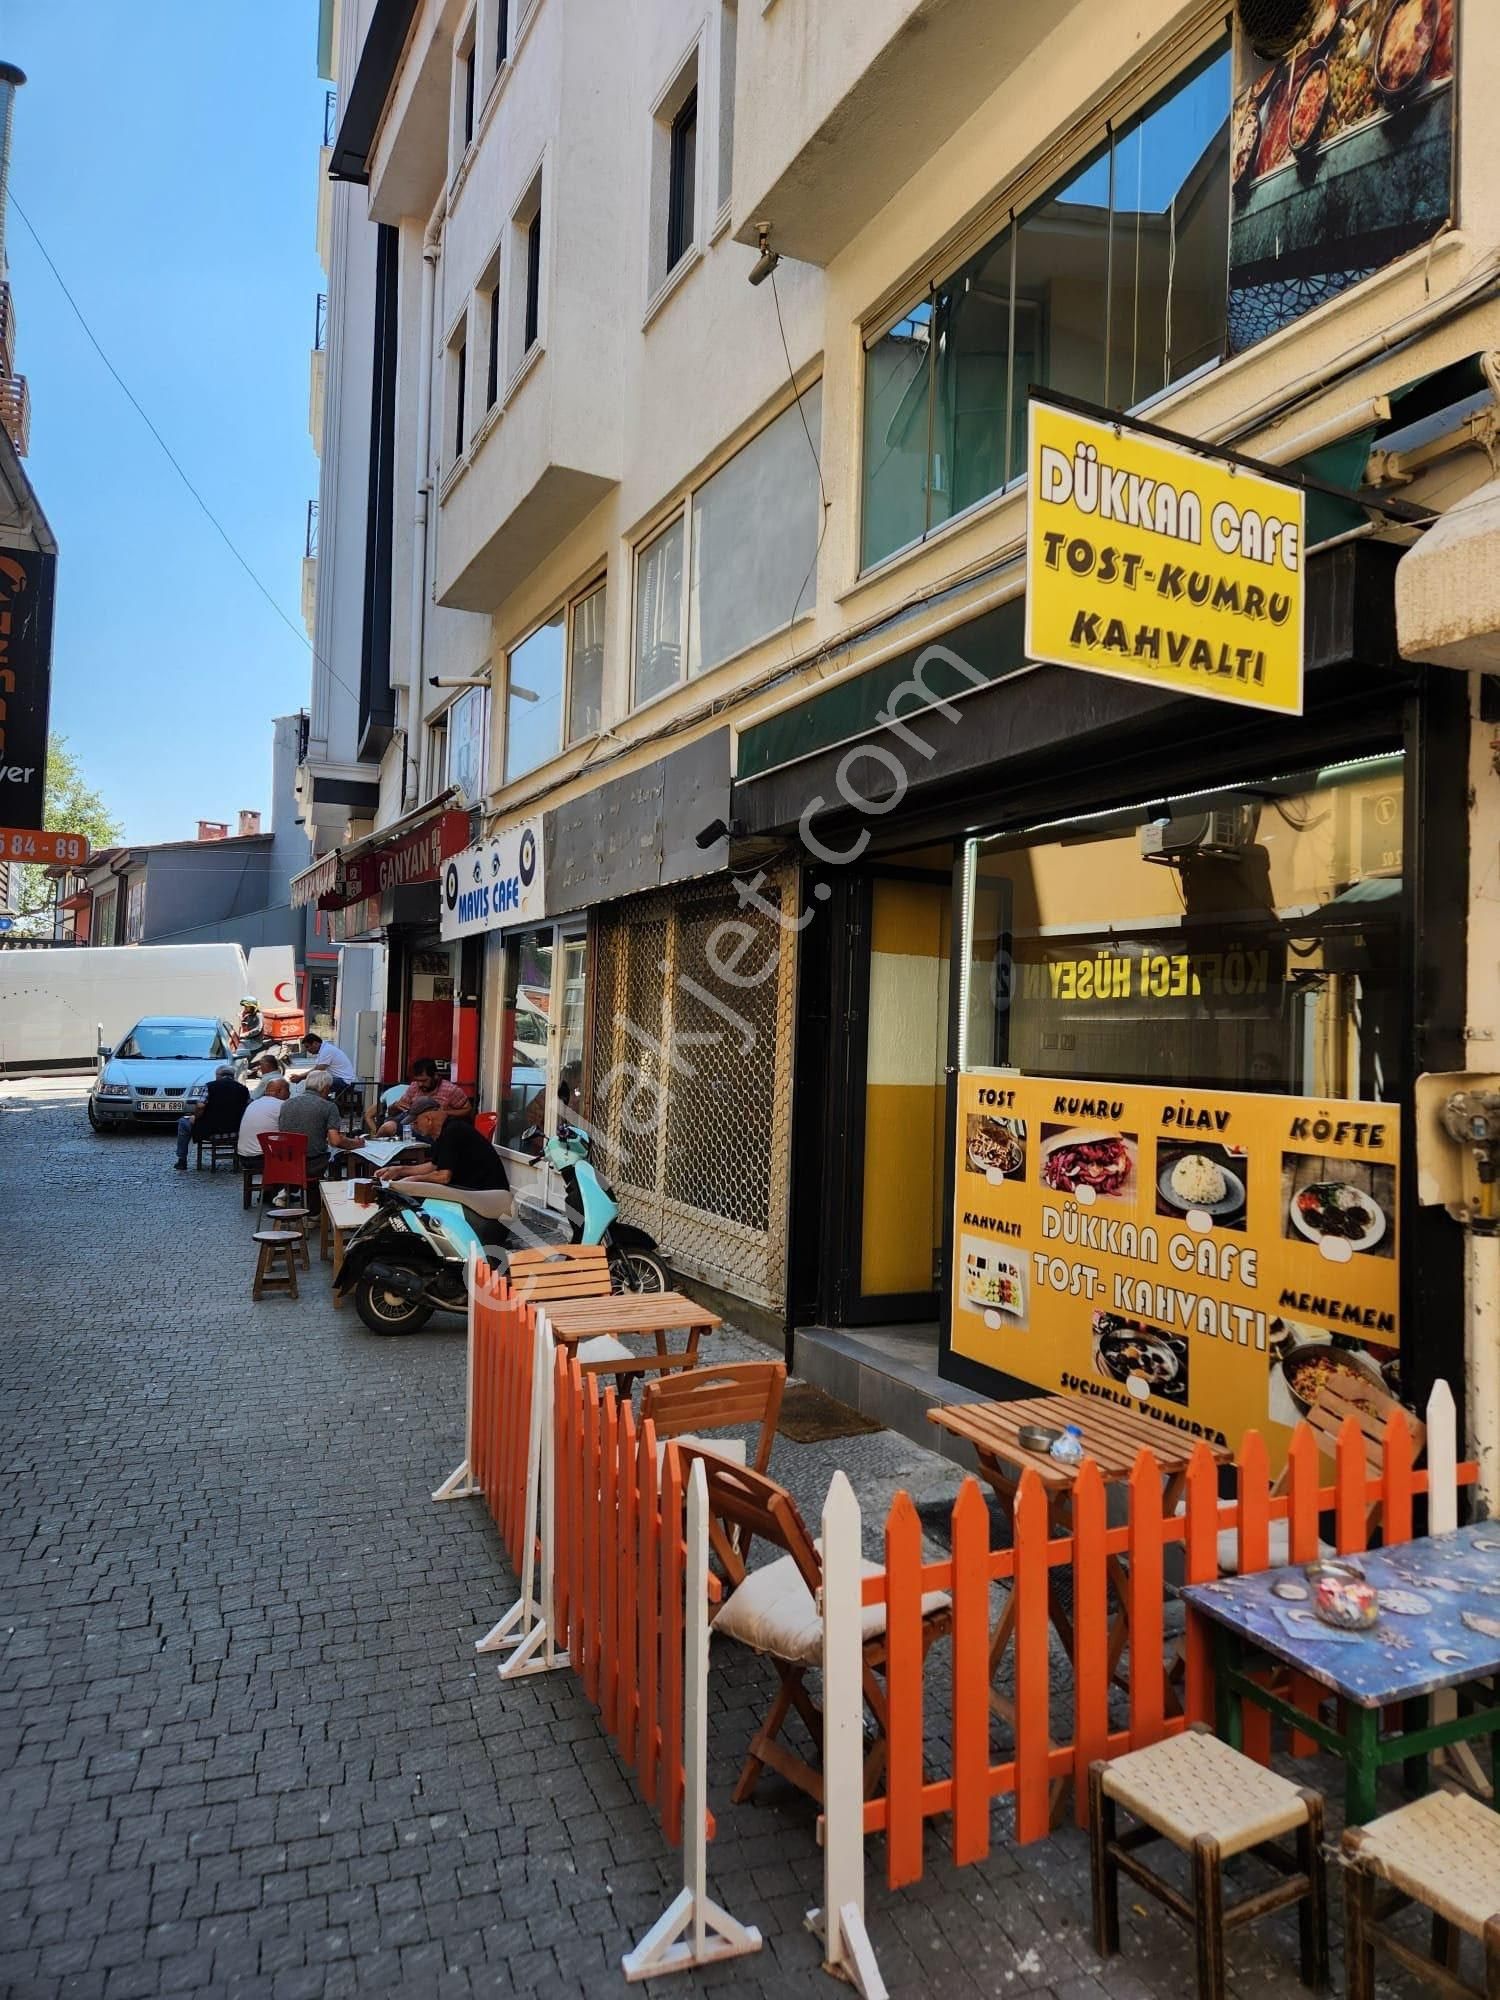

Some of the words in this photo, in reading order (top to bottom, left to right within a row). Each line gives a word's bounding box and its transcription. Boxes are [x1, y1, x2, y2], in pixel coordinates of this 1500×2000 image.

[1040, 441, 1202, 545] DÜKKAN
[1210, 500, 1298, 572] CAFE
[1043, 531, 1290, 626] TOST-KUMRU
[1069, 610, 1265, 686] KAHVALTI
[55, 838, 79, 860] 89
[380, 838, 429, 891] GANYAN
[493, 874, 519, 914] CAFE
[978, 1088, 1015, 1108] TOST
[1053, 1096, 1124, 1120] KUMRU
[1162, 1099, 1231, 1132] PİLAV
[1290, 1111, 1386, 1149] KÖFTE
[963, 1212, 1022, 1238] KAHVALTI
[1041, 1201, 1159, 1264] DÜKKAN
[1168, 1232, 1259, 1288] CAFE
[1033, 1253, 1107, 1300] TOST-
[1113, 1273, 1267, 1352] KAHVALTI
[1279, 1288, 1396, 1334] MENEMEN
